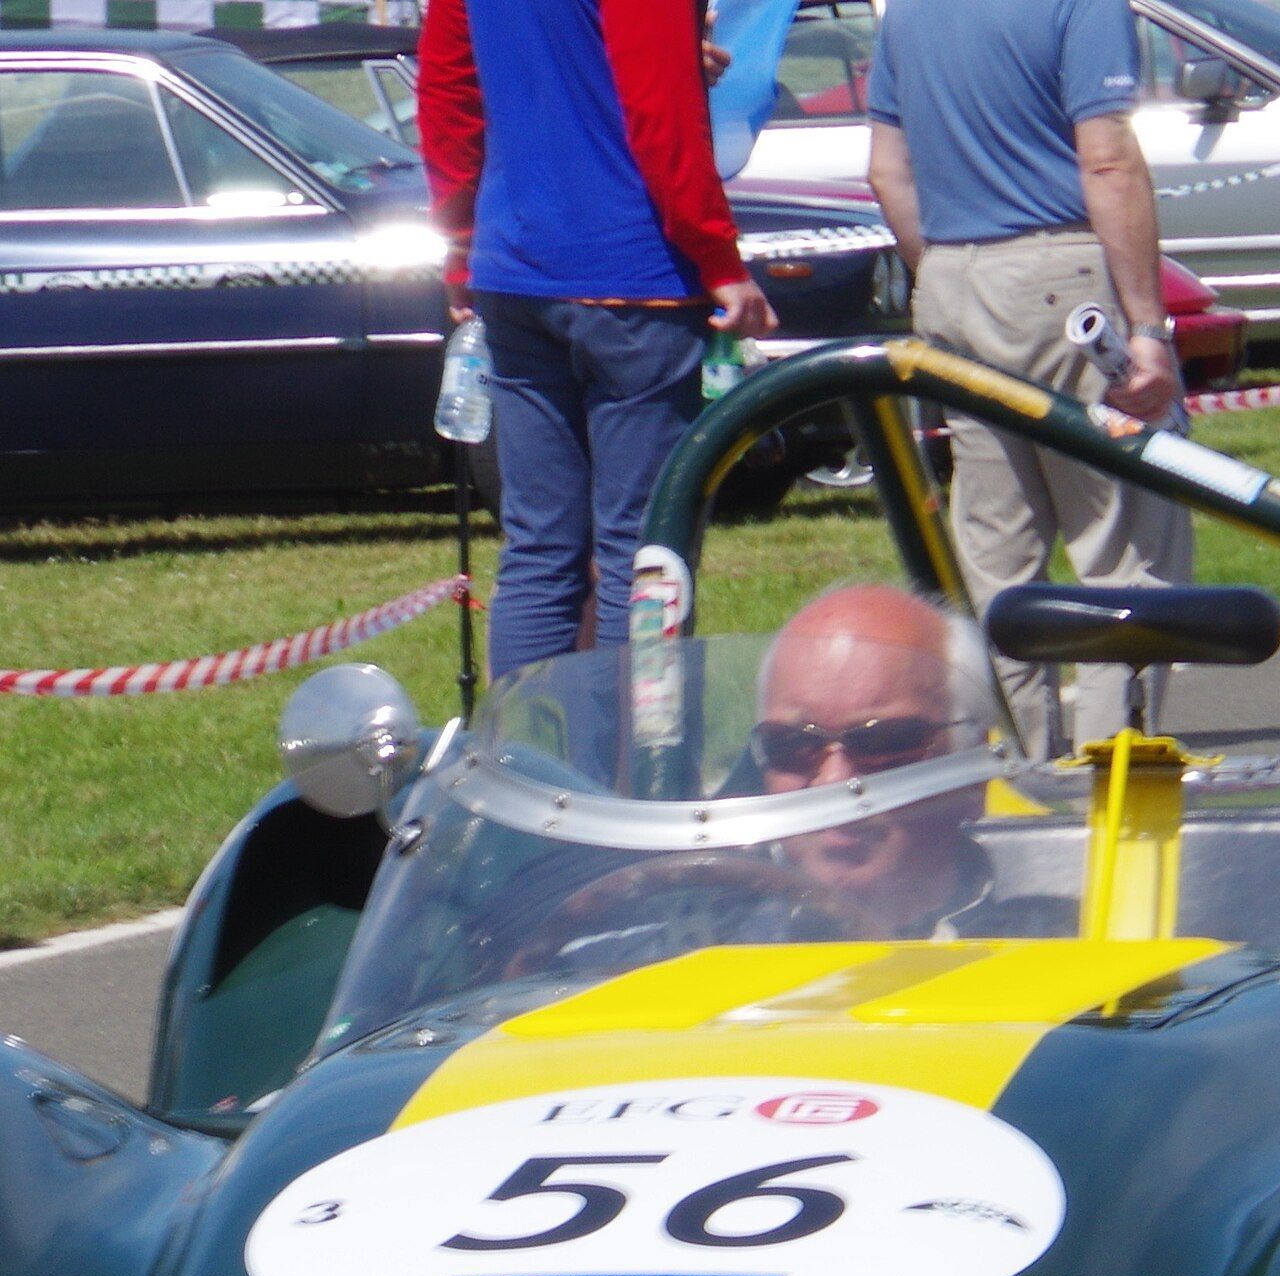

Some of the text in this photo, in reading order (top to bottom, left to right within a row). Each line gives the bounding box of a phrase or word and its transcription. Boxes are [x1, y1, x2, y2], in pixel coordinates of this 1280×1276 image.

[539, 1096, 744, 1126] EFG
[298, 1199, 343, 1226] 3
[435, 1153, 861, 1252] 56
